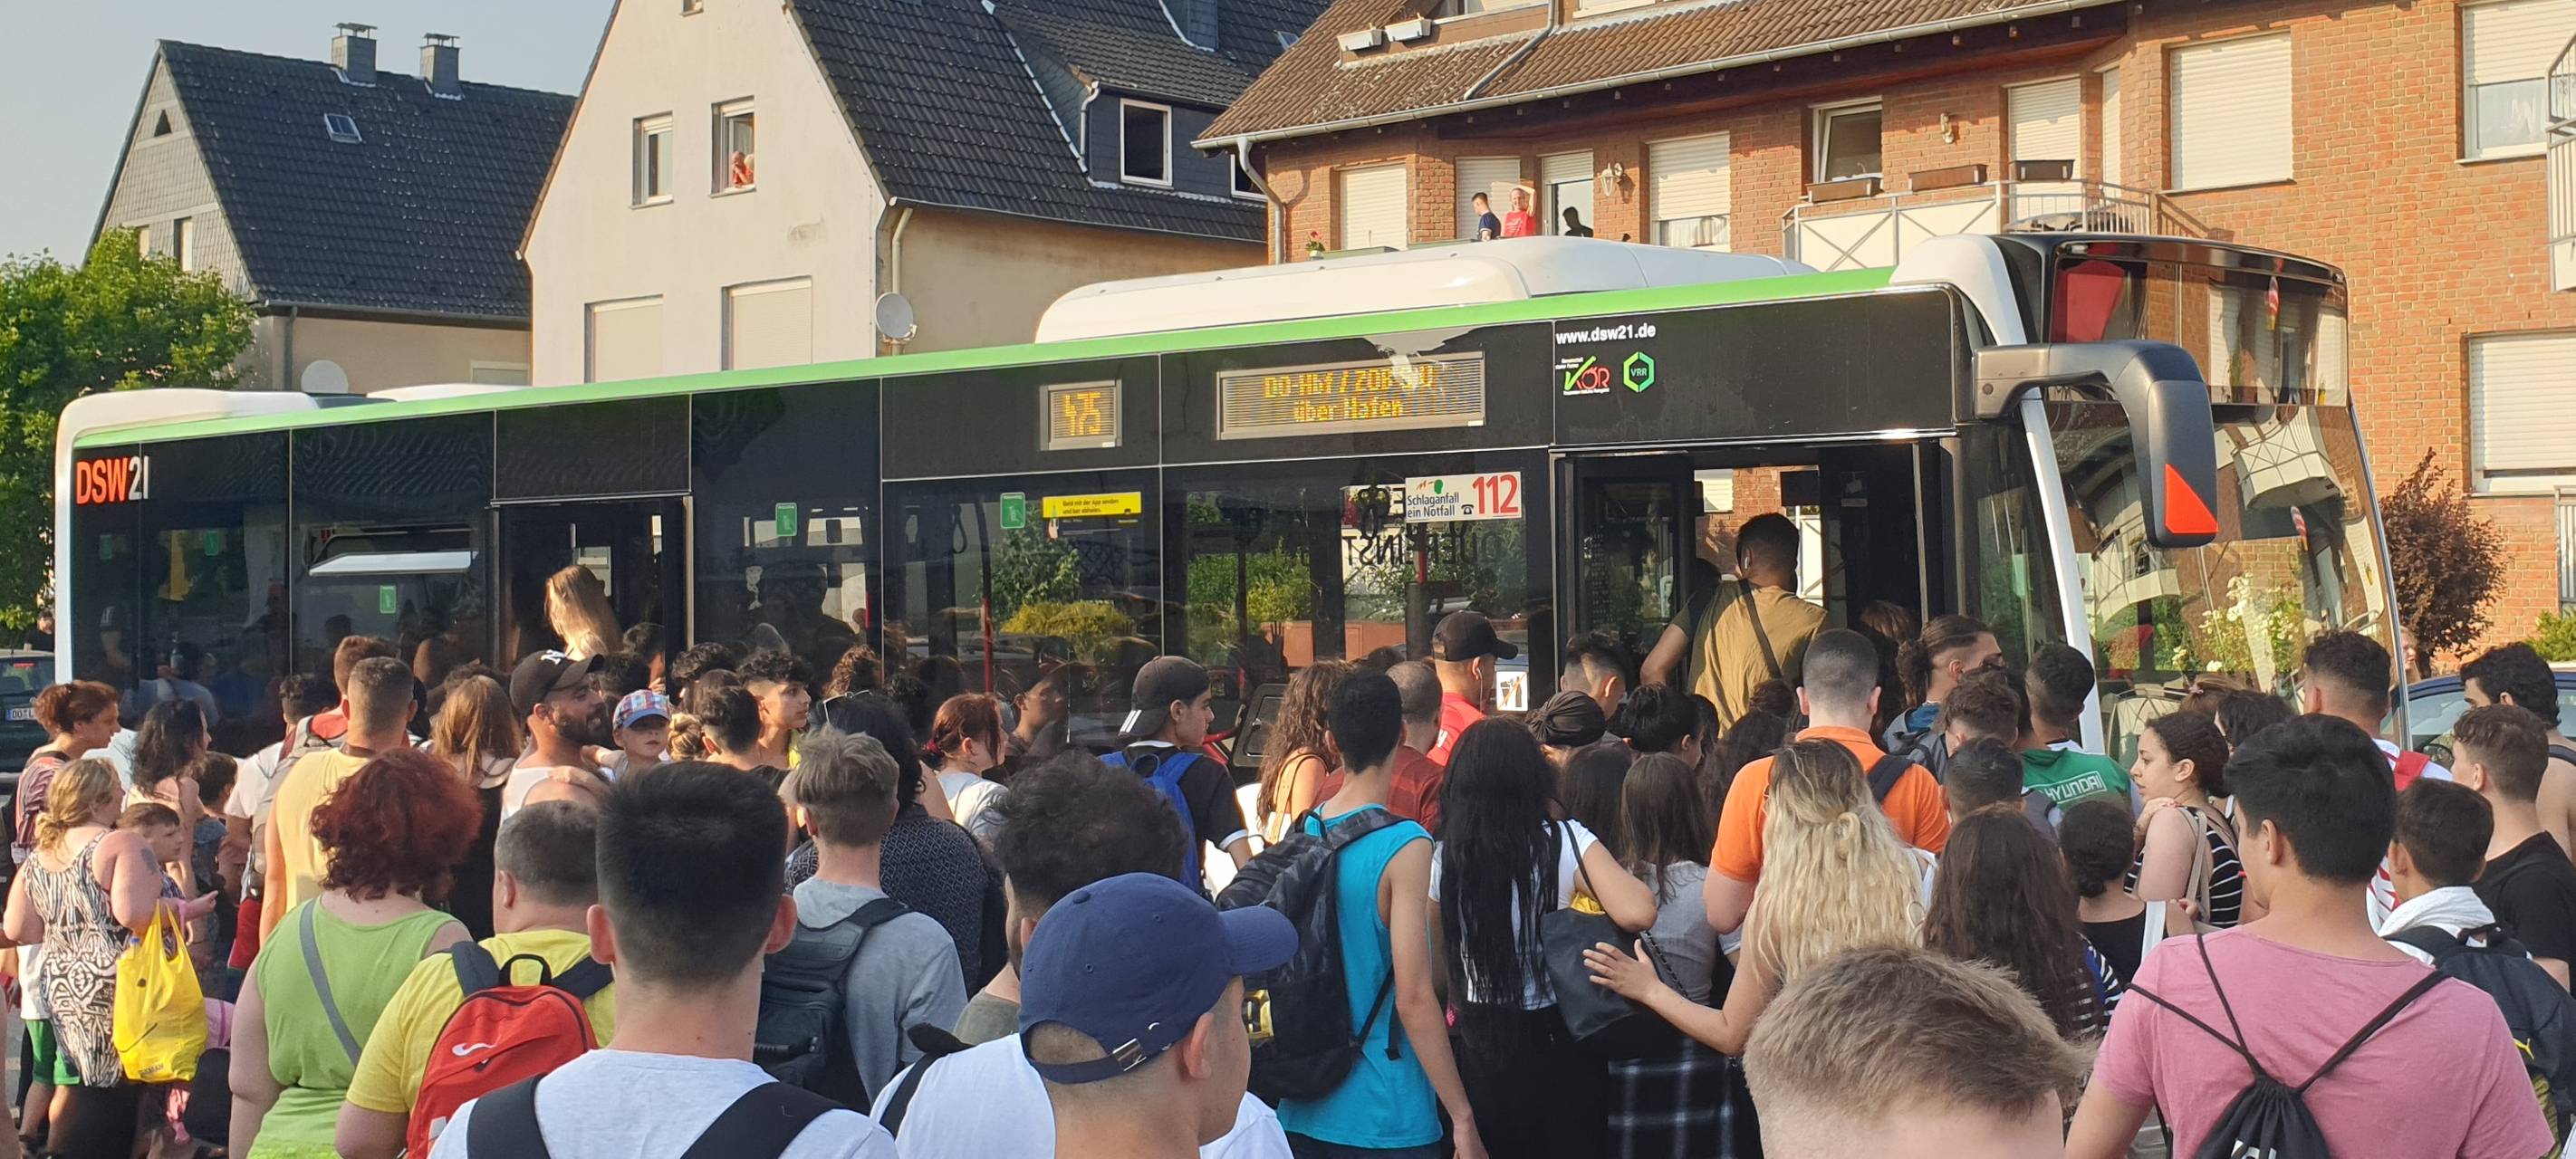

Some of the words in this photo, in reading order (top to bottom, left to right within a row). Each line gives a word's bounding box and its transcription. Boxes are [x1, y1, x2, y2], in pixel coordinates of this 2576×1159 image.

[1555, 322, 1657, 344] www.dsw21.de
[1630, 368, 1647, 377] VRR
[1064, 391, 1102, 436] 475
[1293, 398, 1339, 423] über
[1343, 396, 1403, 420] Hafen
[76, 455, 149, 504] DSW21
[1408, 492, 1459, 508] Schlaganfall
[1472, 474, 1519, 514] 112
[1408, 508, 1421, 518] ein
[1423, 504, 1456, 518] Notfall
[2043, 774, 2103, 801] HYUNDAI
